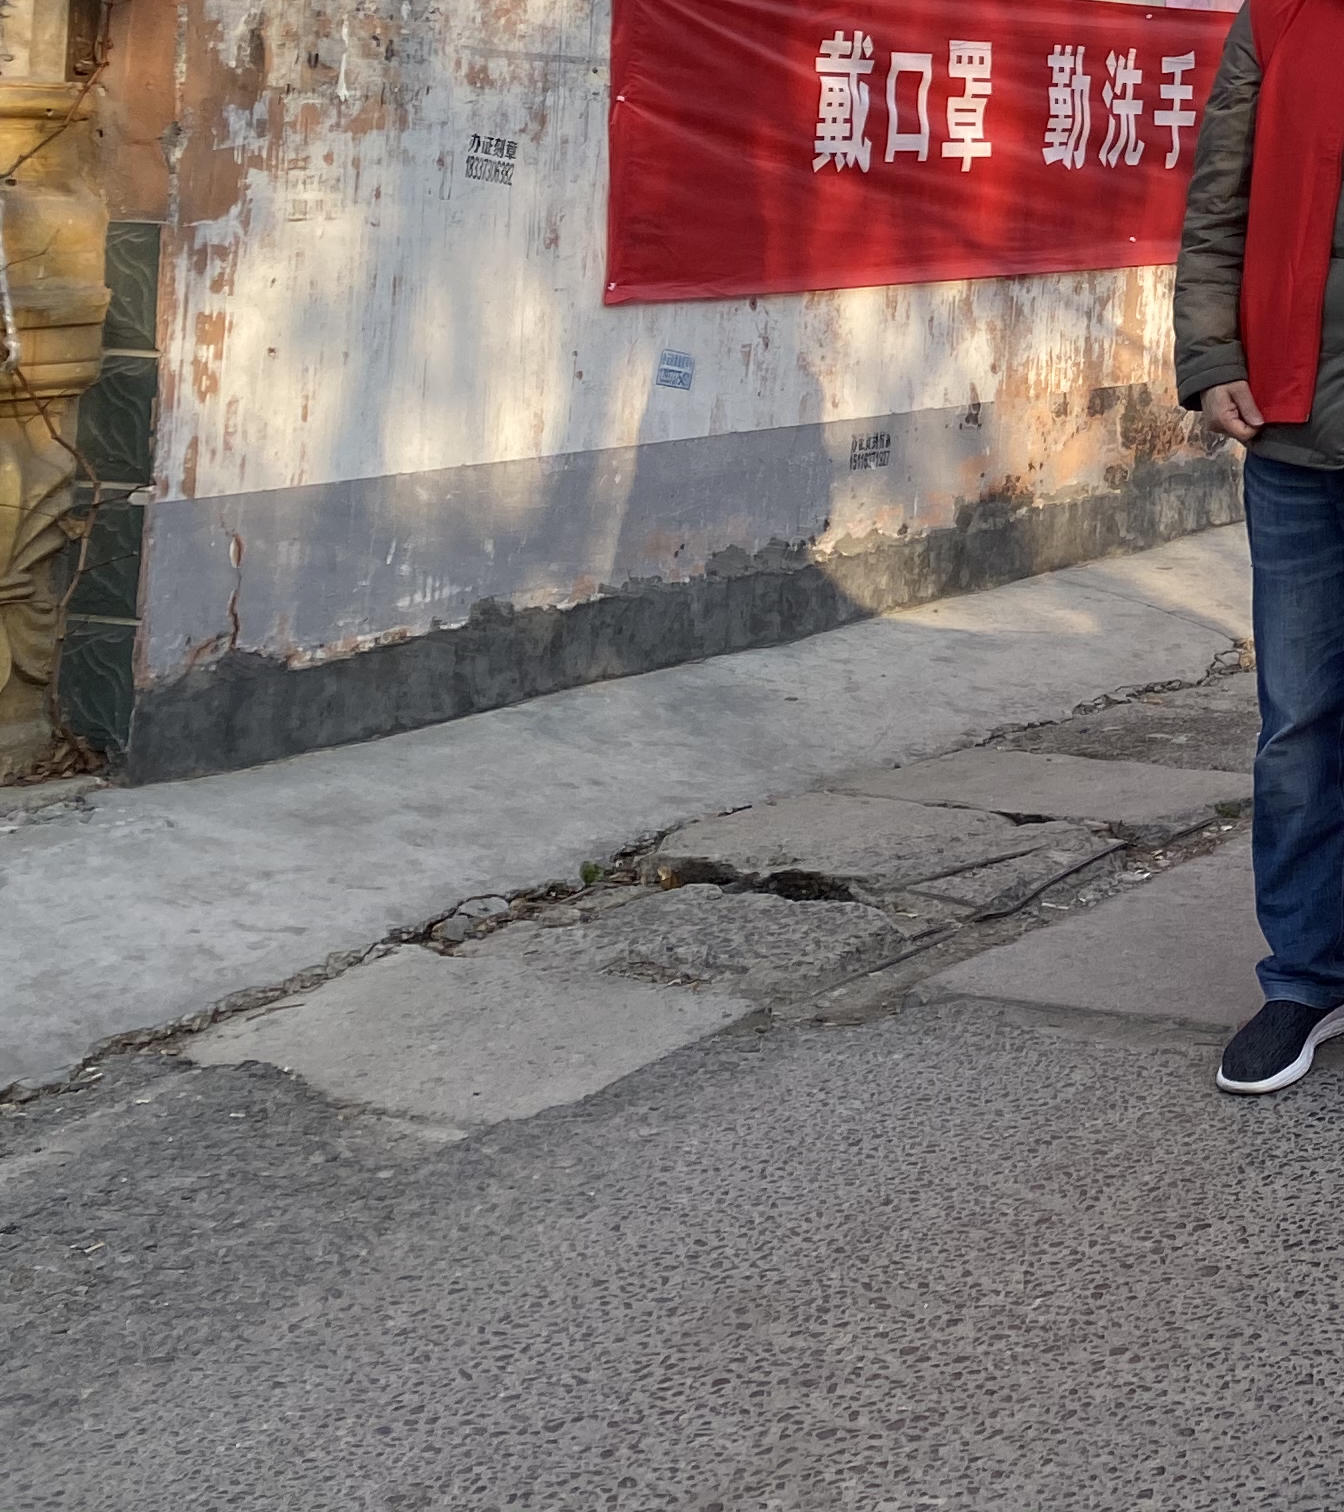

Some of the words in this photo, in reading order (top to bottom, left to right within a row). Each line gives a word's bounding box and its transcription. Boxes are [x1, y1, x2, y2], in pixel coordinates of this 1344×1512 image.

[811, 30, 993, 173] 戴口罩
[1041, 44, 1197, 170] 勤洗手
[467, 133, 518, 159] 办证刻章
